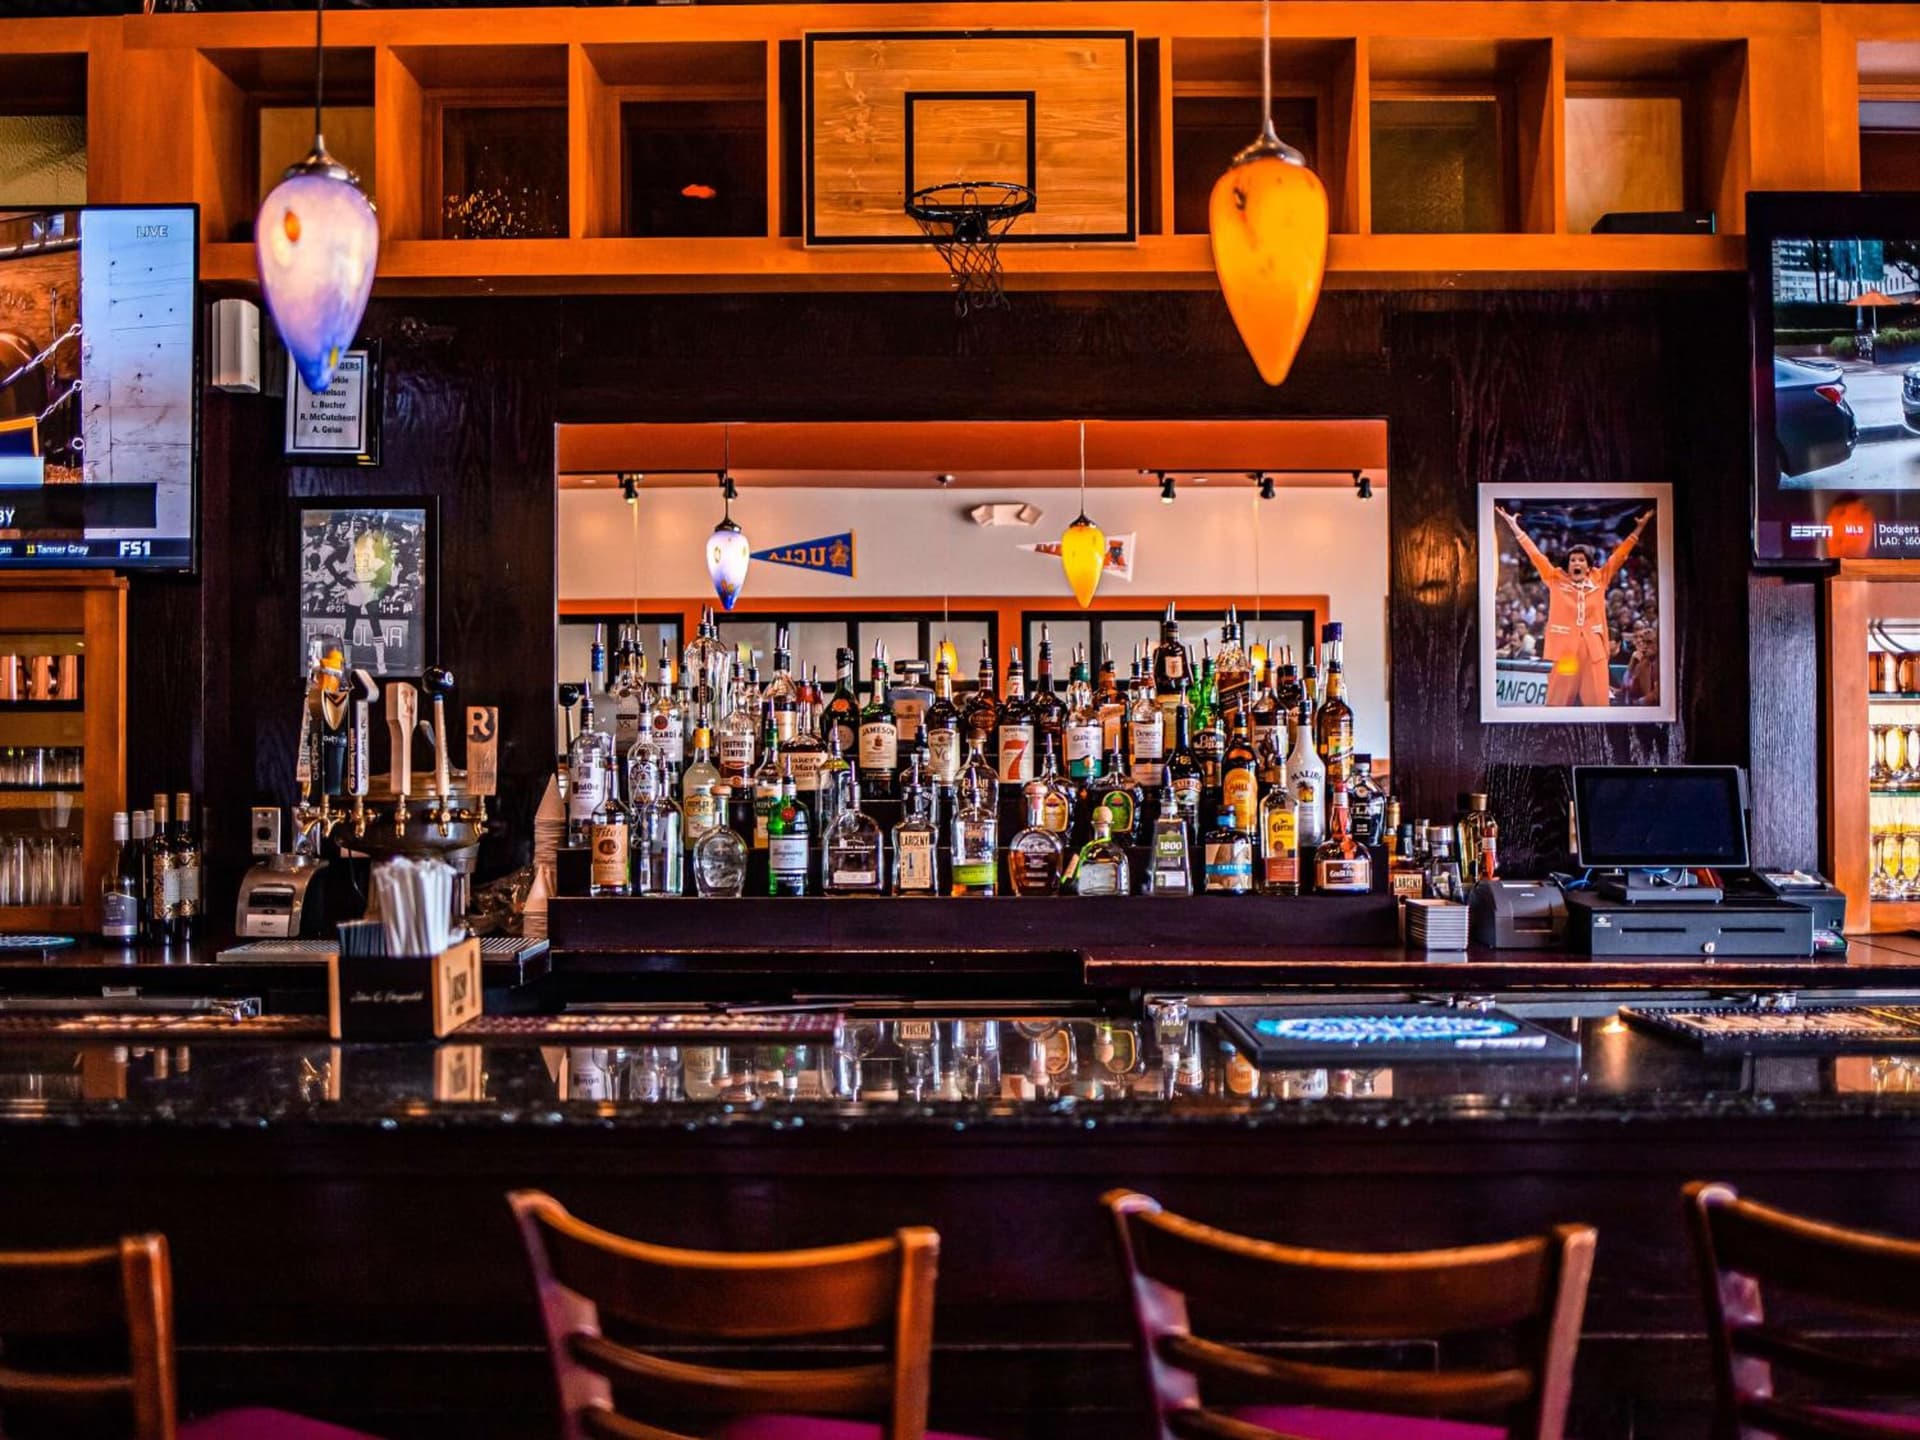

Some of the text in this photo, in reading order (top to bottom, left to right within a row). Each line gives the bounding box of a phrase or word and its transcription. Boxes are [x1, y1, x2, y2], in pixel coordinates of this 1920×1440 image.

[137, 225, 168, 238] LIVE
[1791, 525, 1833, 537] ESPN
[1879, 524, 1919, 536] Dodgers
[37, 545, 66, 553] Tanner
[67, 545, 89, 556] Gray
[119, 541, 151, 555] FS1
[1496, 679, 1547, 705] ANFOR
[469, 707, 490, 736] R
[862, 726, 895, 737] JAMESON
[1003, 739, 1029, 780] 7
[902, 834, 929, 847] LARCENY
[1160, 841, 1182, 851] 1800
